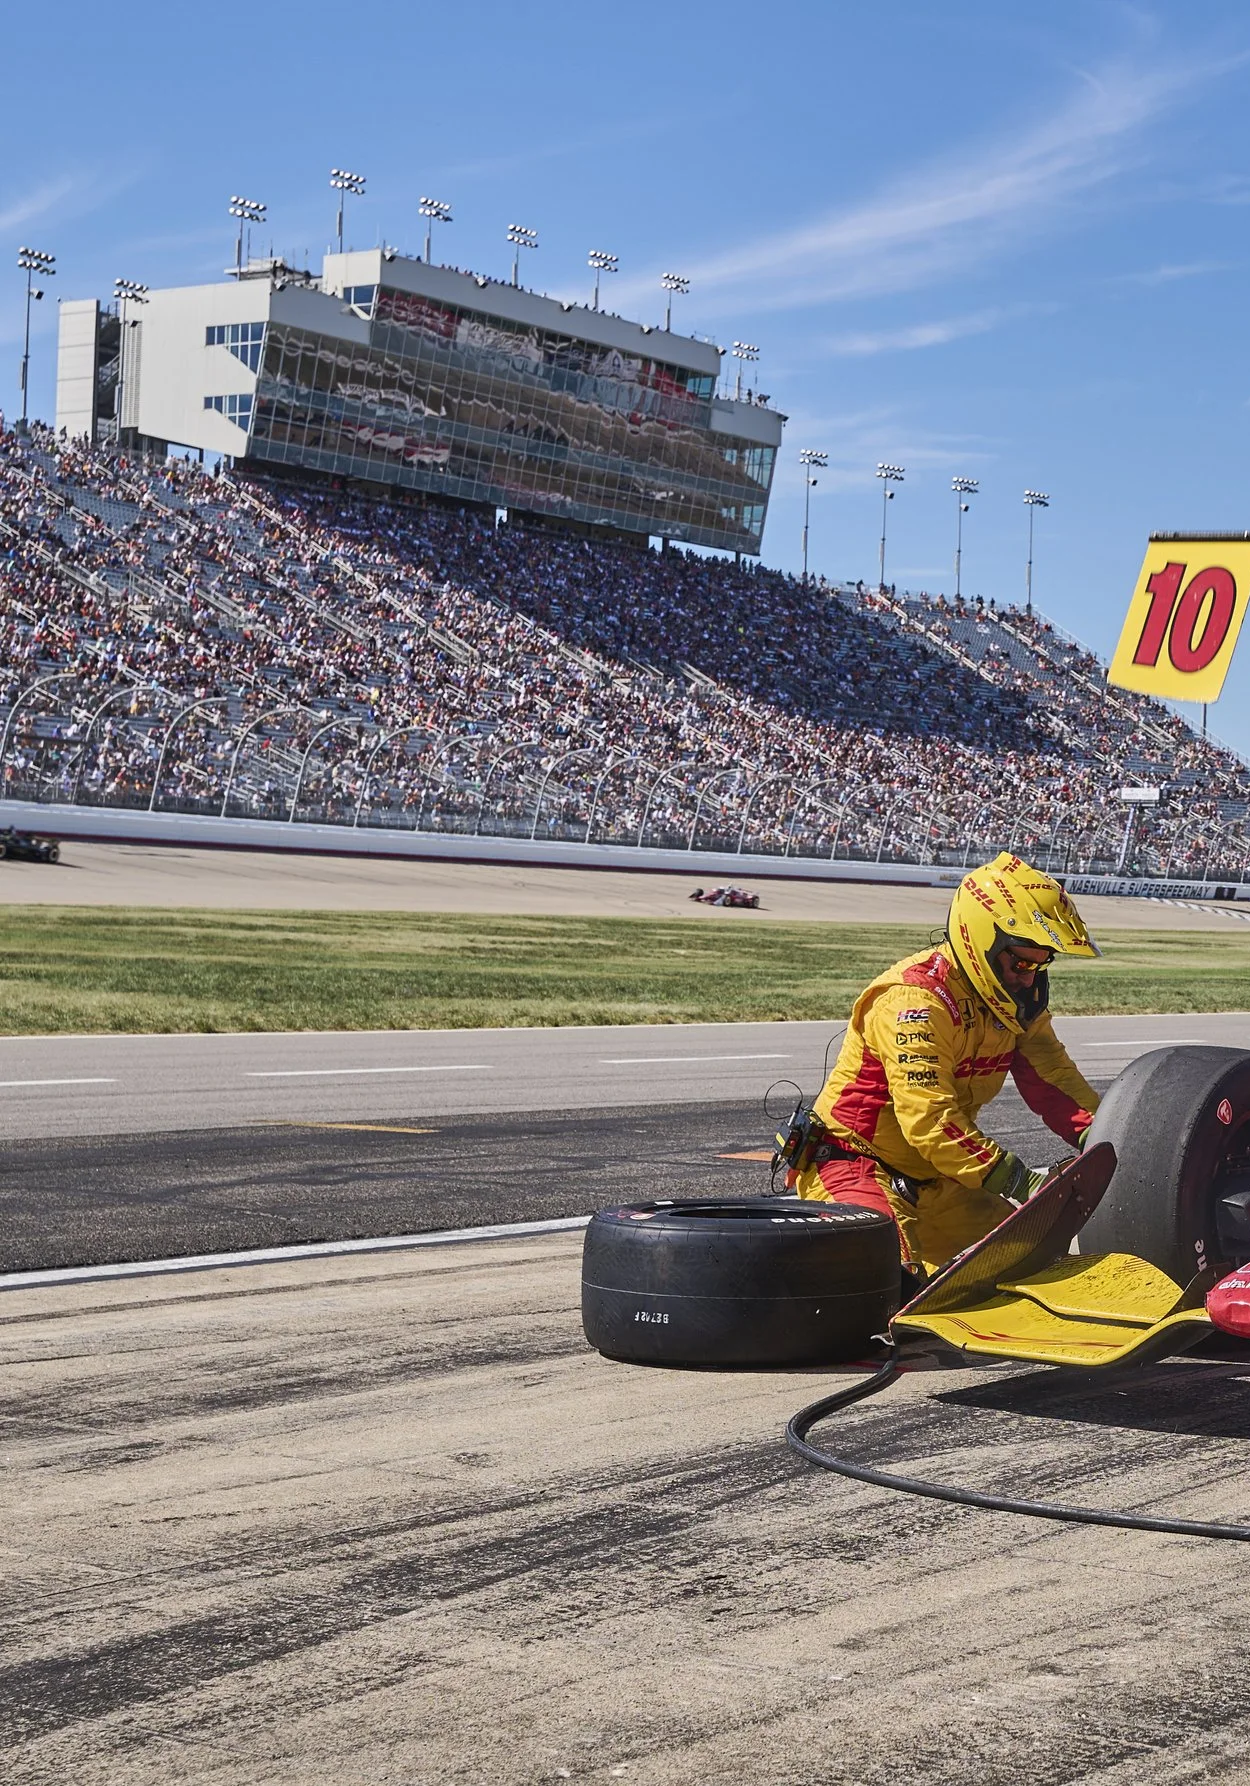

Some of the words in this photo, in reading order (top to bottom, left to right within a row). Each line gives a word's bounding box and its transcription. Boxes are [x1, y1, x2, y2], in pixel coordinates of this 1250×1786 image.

[1132, 561, 1238, 673] 10
[964, 878, 997, 913] DHL
[994, 878, 1017, 909] DHL
[1069, 879, 1126, 896] NASHVILLE
[1127, 883, 1212, 898] SUPERSPEEDWAY
[959, 922, 982, 977] DHL
[897, 1008, 931, 1021] HRC
[910, 1033, 935, 1043] PNC
[942, 1120, 996, 1165] DHL
[771, 1211, 880, 1224] Firestone
